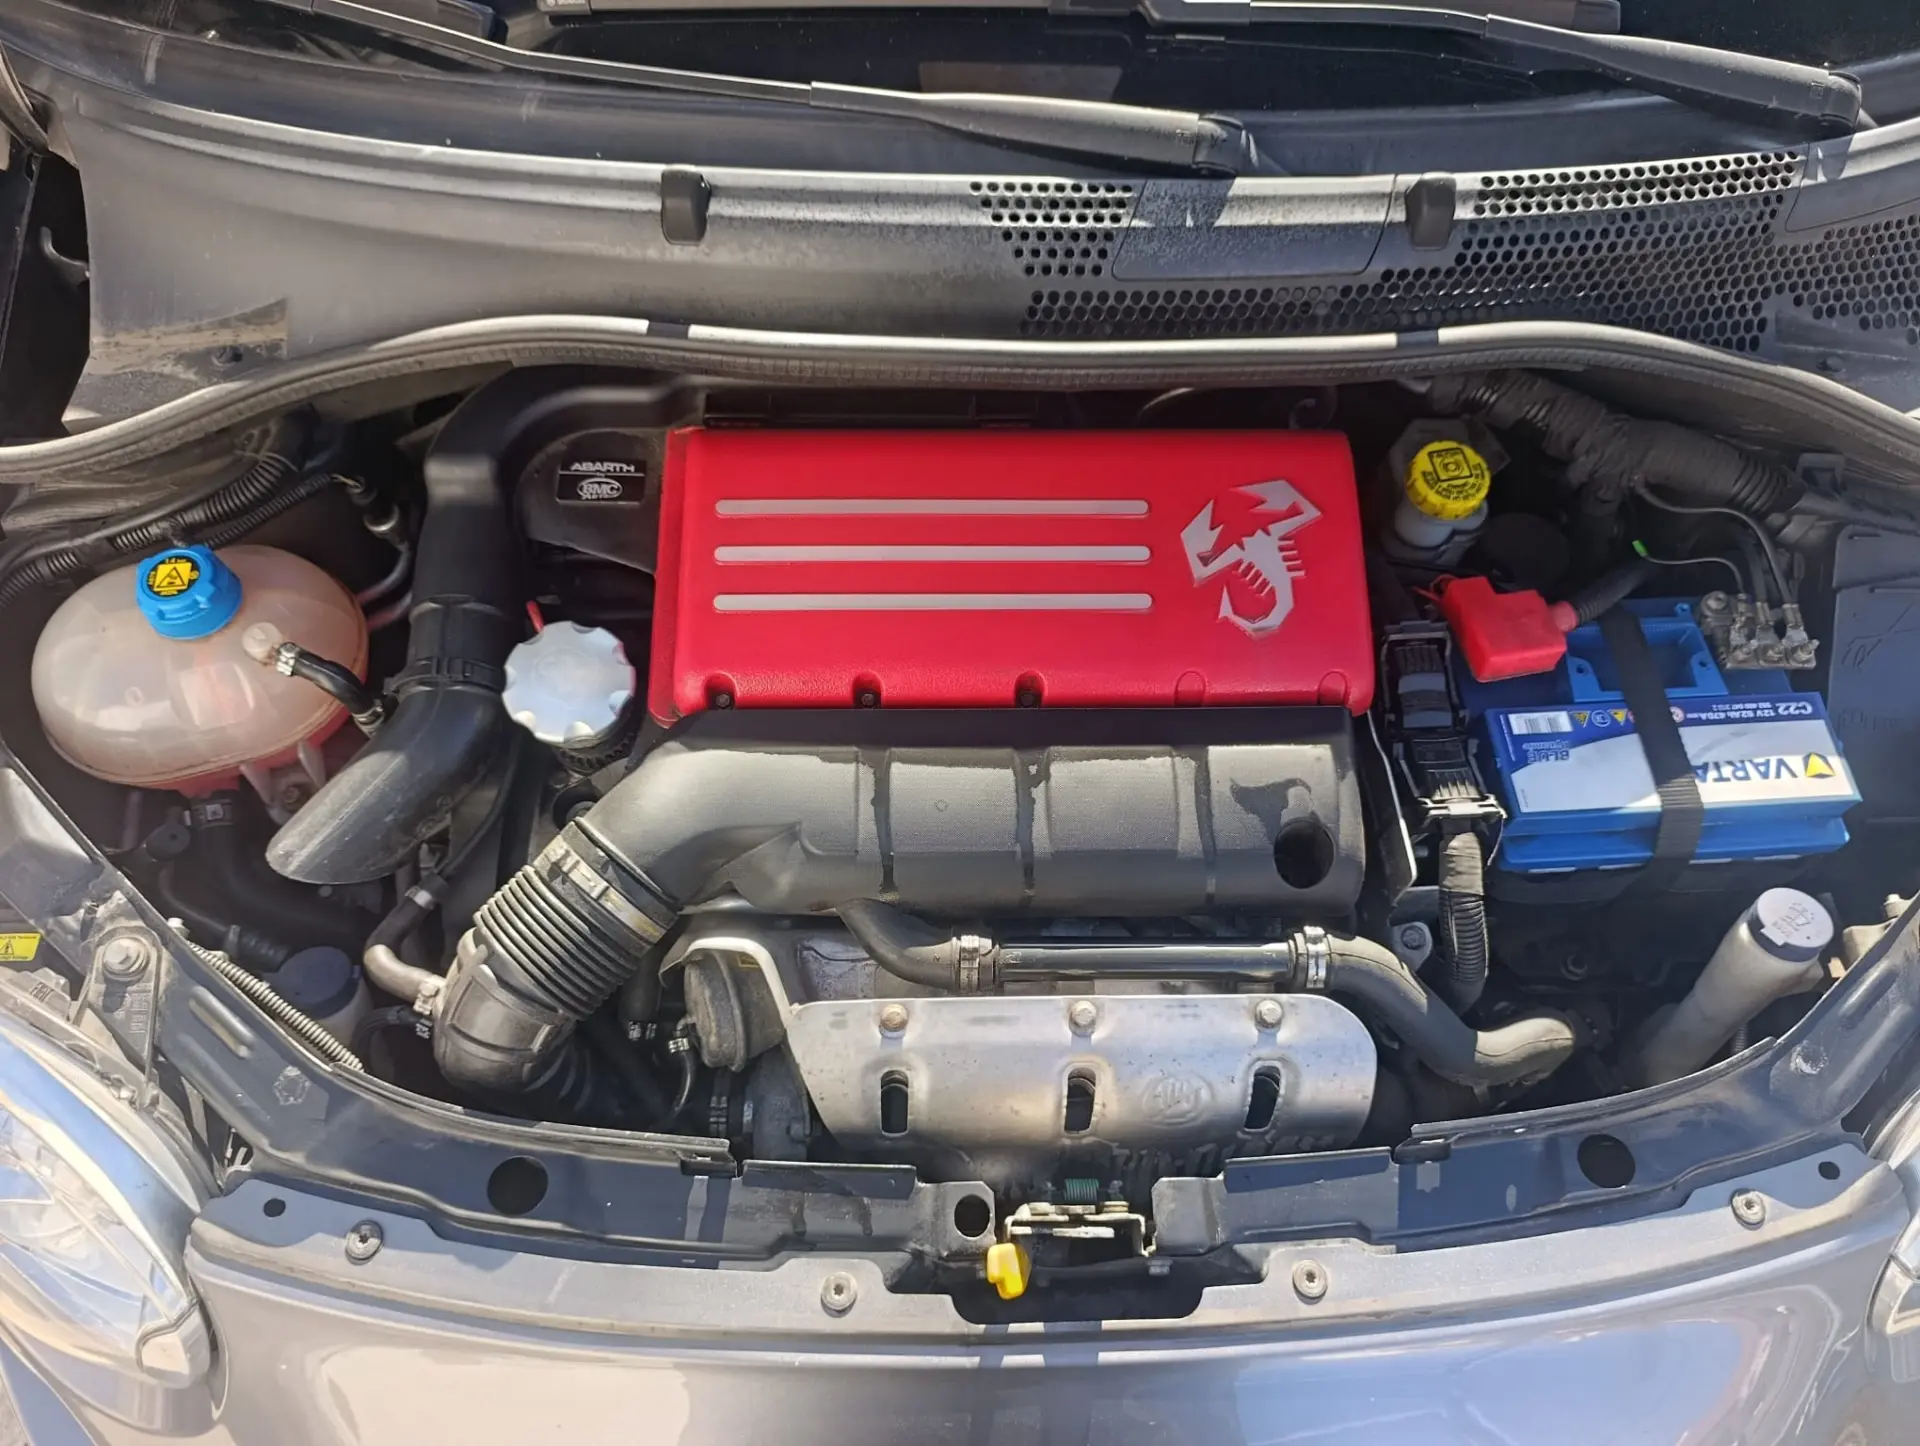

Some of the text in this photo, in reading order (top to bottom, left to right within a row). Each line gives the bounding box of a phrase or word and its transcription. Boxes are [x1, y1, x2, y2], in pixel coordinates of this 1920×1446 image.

[570, 461, 635, 473] ABARTH
[582, 483, 618, 494] BMC
[1756, 709, 1776, 718] 12V
[1775, 701, 1813, 716] C22
[1527, 749, 1571, 764] BLUE
[1692, 757, 1799, 783] VARTA
